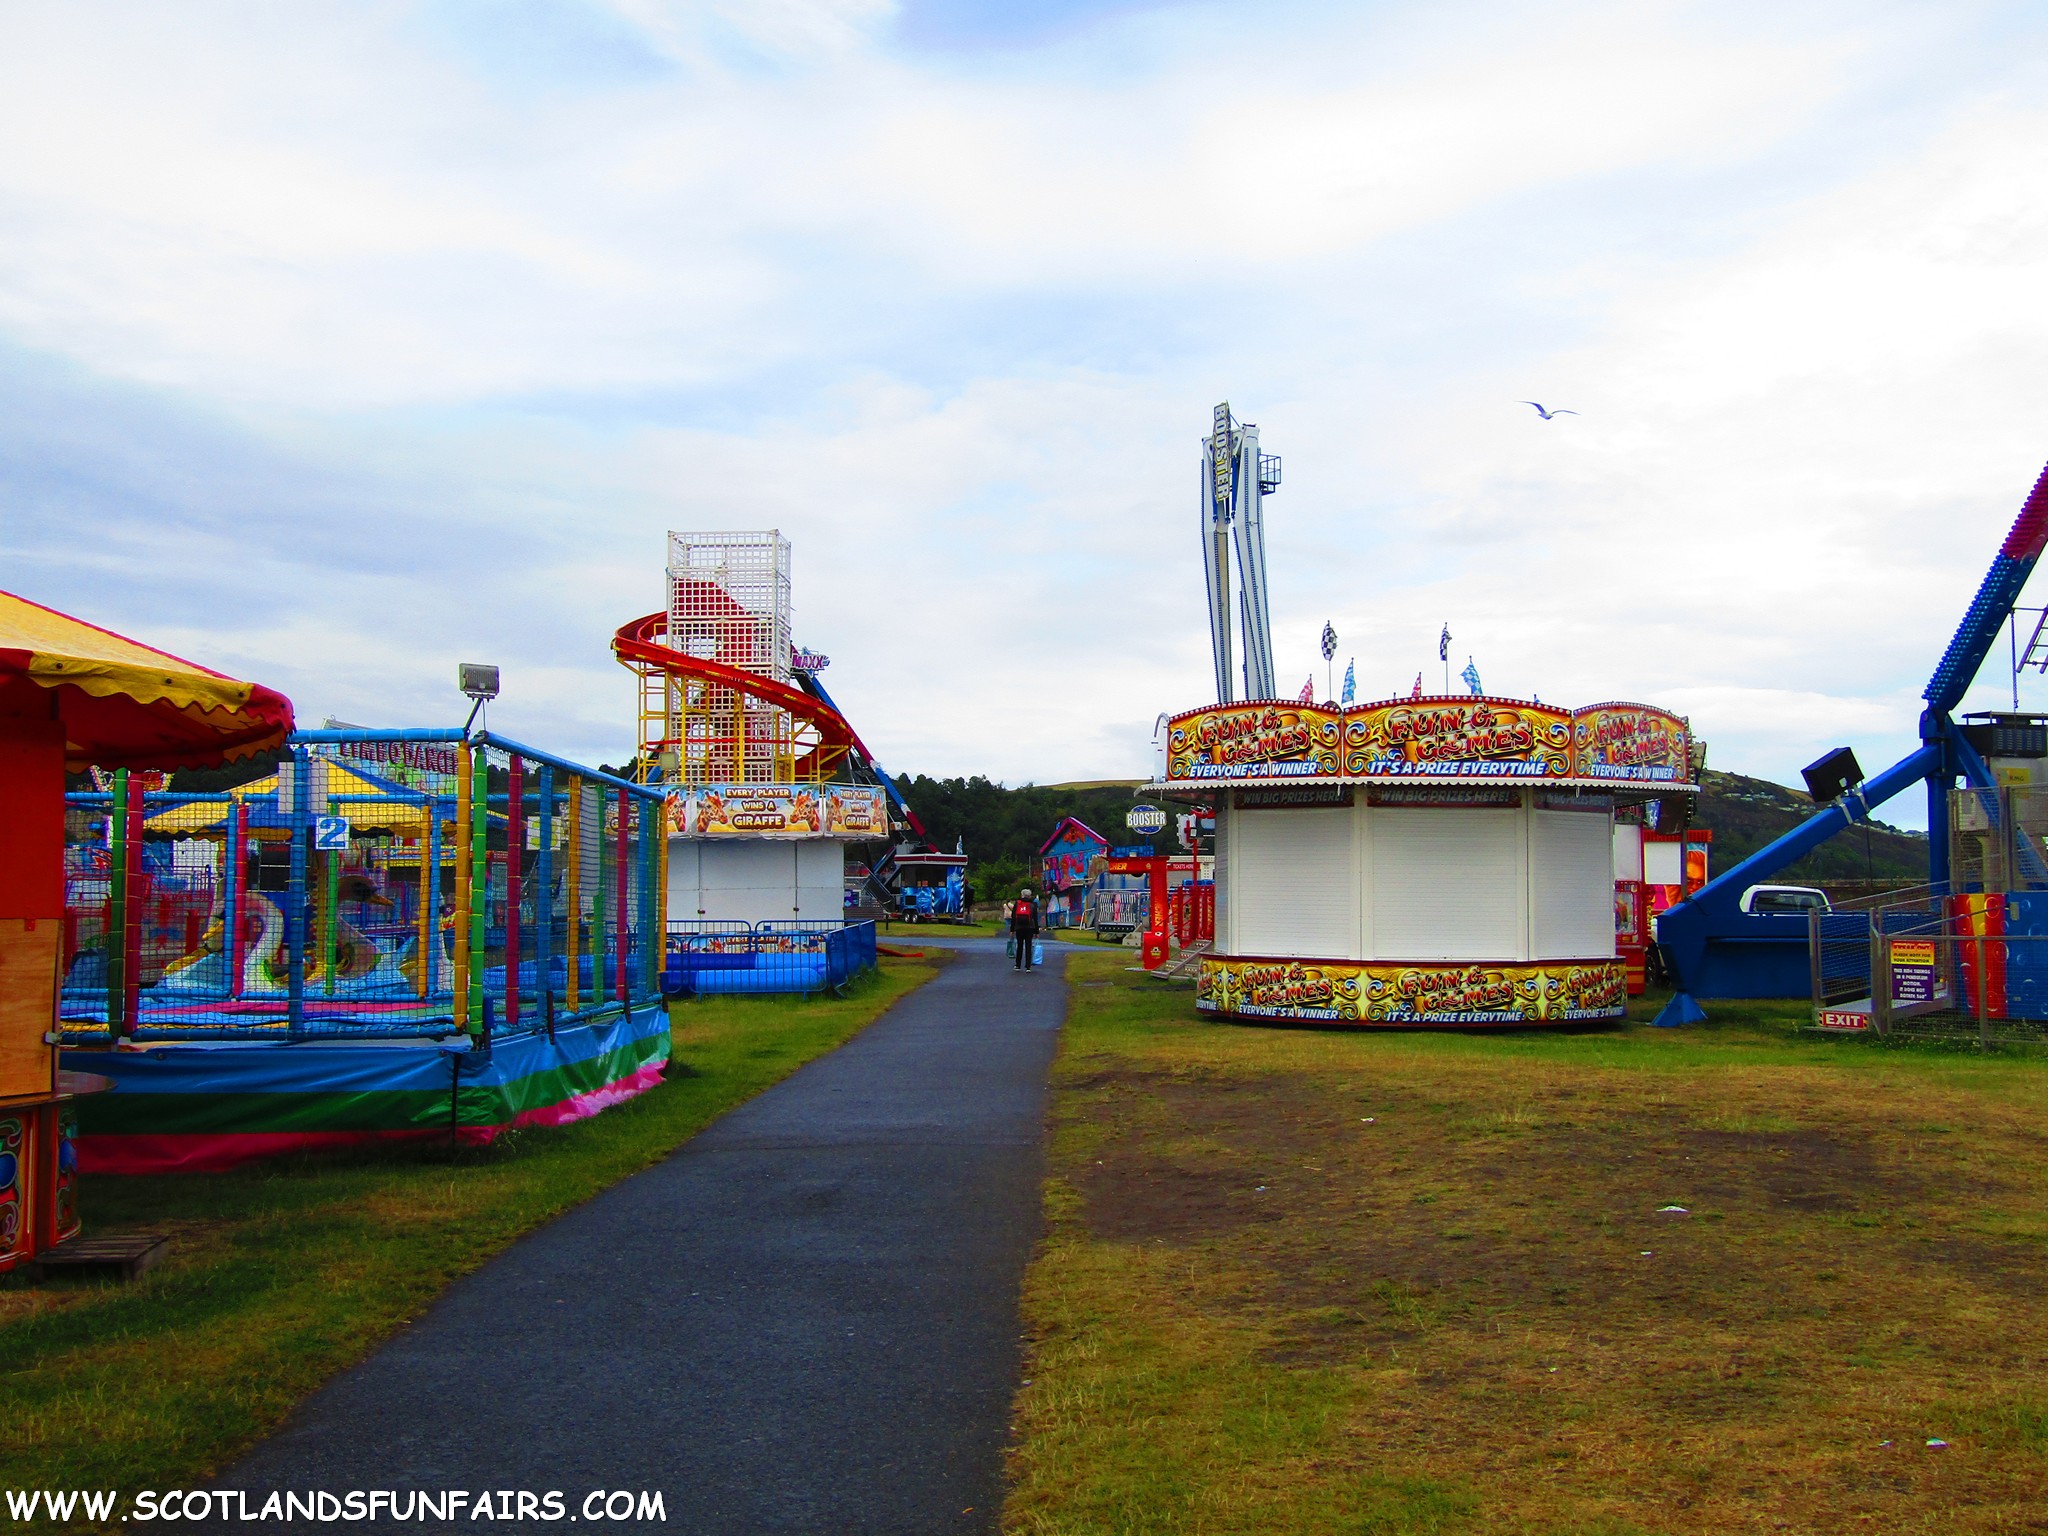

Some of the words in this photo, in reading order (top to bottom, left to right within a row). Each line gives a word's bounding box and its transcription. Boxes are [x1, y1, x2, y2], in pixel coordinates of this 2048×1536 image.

[1214, 403, 1229, 499] BOOSTER
[792, 655, 823, 668] MAXX
[1202, 712, 1257, 746] FUN
[1389, 706, 1466, 745] FUN
[1598, 715, 1637, 747] FUN
[1220, 722, 1310, 765] GAMES
[1417, 721, 1533, 762] GAMES
[1611, 730, 1668, 765] GAMES
[1189, 763, 1259, 777] EVERYONE'S
[1260, 763, 1268, 776] A
[1269, 762, 1318, 775] WINNER
[1370, 761, 1400, 774] IT'S
[1402, 762, 1412, 774] A
[1415, 762, 1458, 774] PRIZE
[1461, 762, 1546, 775] EVERYTIME
[1590, 764, 1637, 778] EVERYONE'S
[1637, 768, 1644, 778] A
[1645, 766, 1674, 779] WINNER
[726, 789, 753, 797] EVERY
[758, 789, 790, 797] PLAYER
[1244, 793, 1260, 804] WIN
[1262, 792, 1279, 803] BIG
[1281, 791, 1315, 803] PRIZES
[1381, 790, 1404, 801] WIN
[1406, 790, 1428, 801] BIG
[1430, 790, 1472, 801] PRIZES
[1474, 790, 1510, 801] HERE!
[742, 802, 764, 811] WINS
[768, 803, 776, 812] A
[734, 815, 782, 827] GIRAFFE
[845, 815, 870, 827] GIRAFFE
[1127, 812, 1166, 827] BOOSTER
[318, 818, 347, 848] 2
[1245, 965, 1285, 989] FUN
[1403, 969, 1462, 997] FUN
[1257, 978, 1332, 1006] GAMES
[1424, 980, 1514, 1012] GAMES
[1239, 1006, 1287, 1017] EVERYONE'S
[1287, 1009, 1294, 1018] A
[1297, 1008, 1338, 1019] WINNER
[1386, 1012, 1410, 1021] IT'S
[1413, 1012, 1420, 1021] A
[1422, 1012, 1456, 1022] PRIZE
[1459, 1012, 1522, 1022] EVERYTIME
[1564, 1008, 1605, 1019] EVERYONE'S
[1826, 1014, 1860, 1026] EXIT
